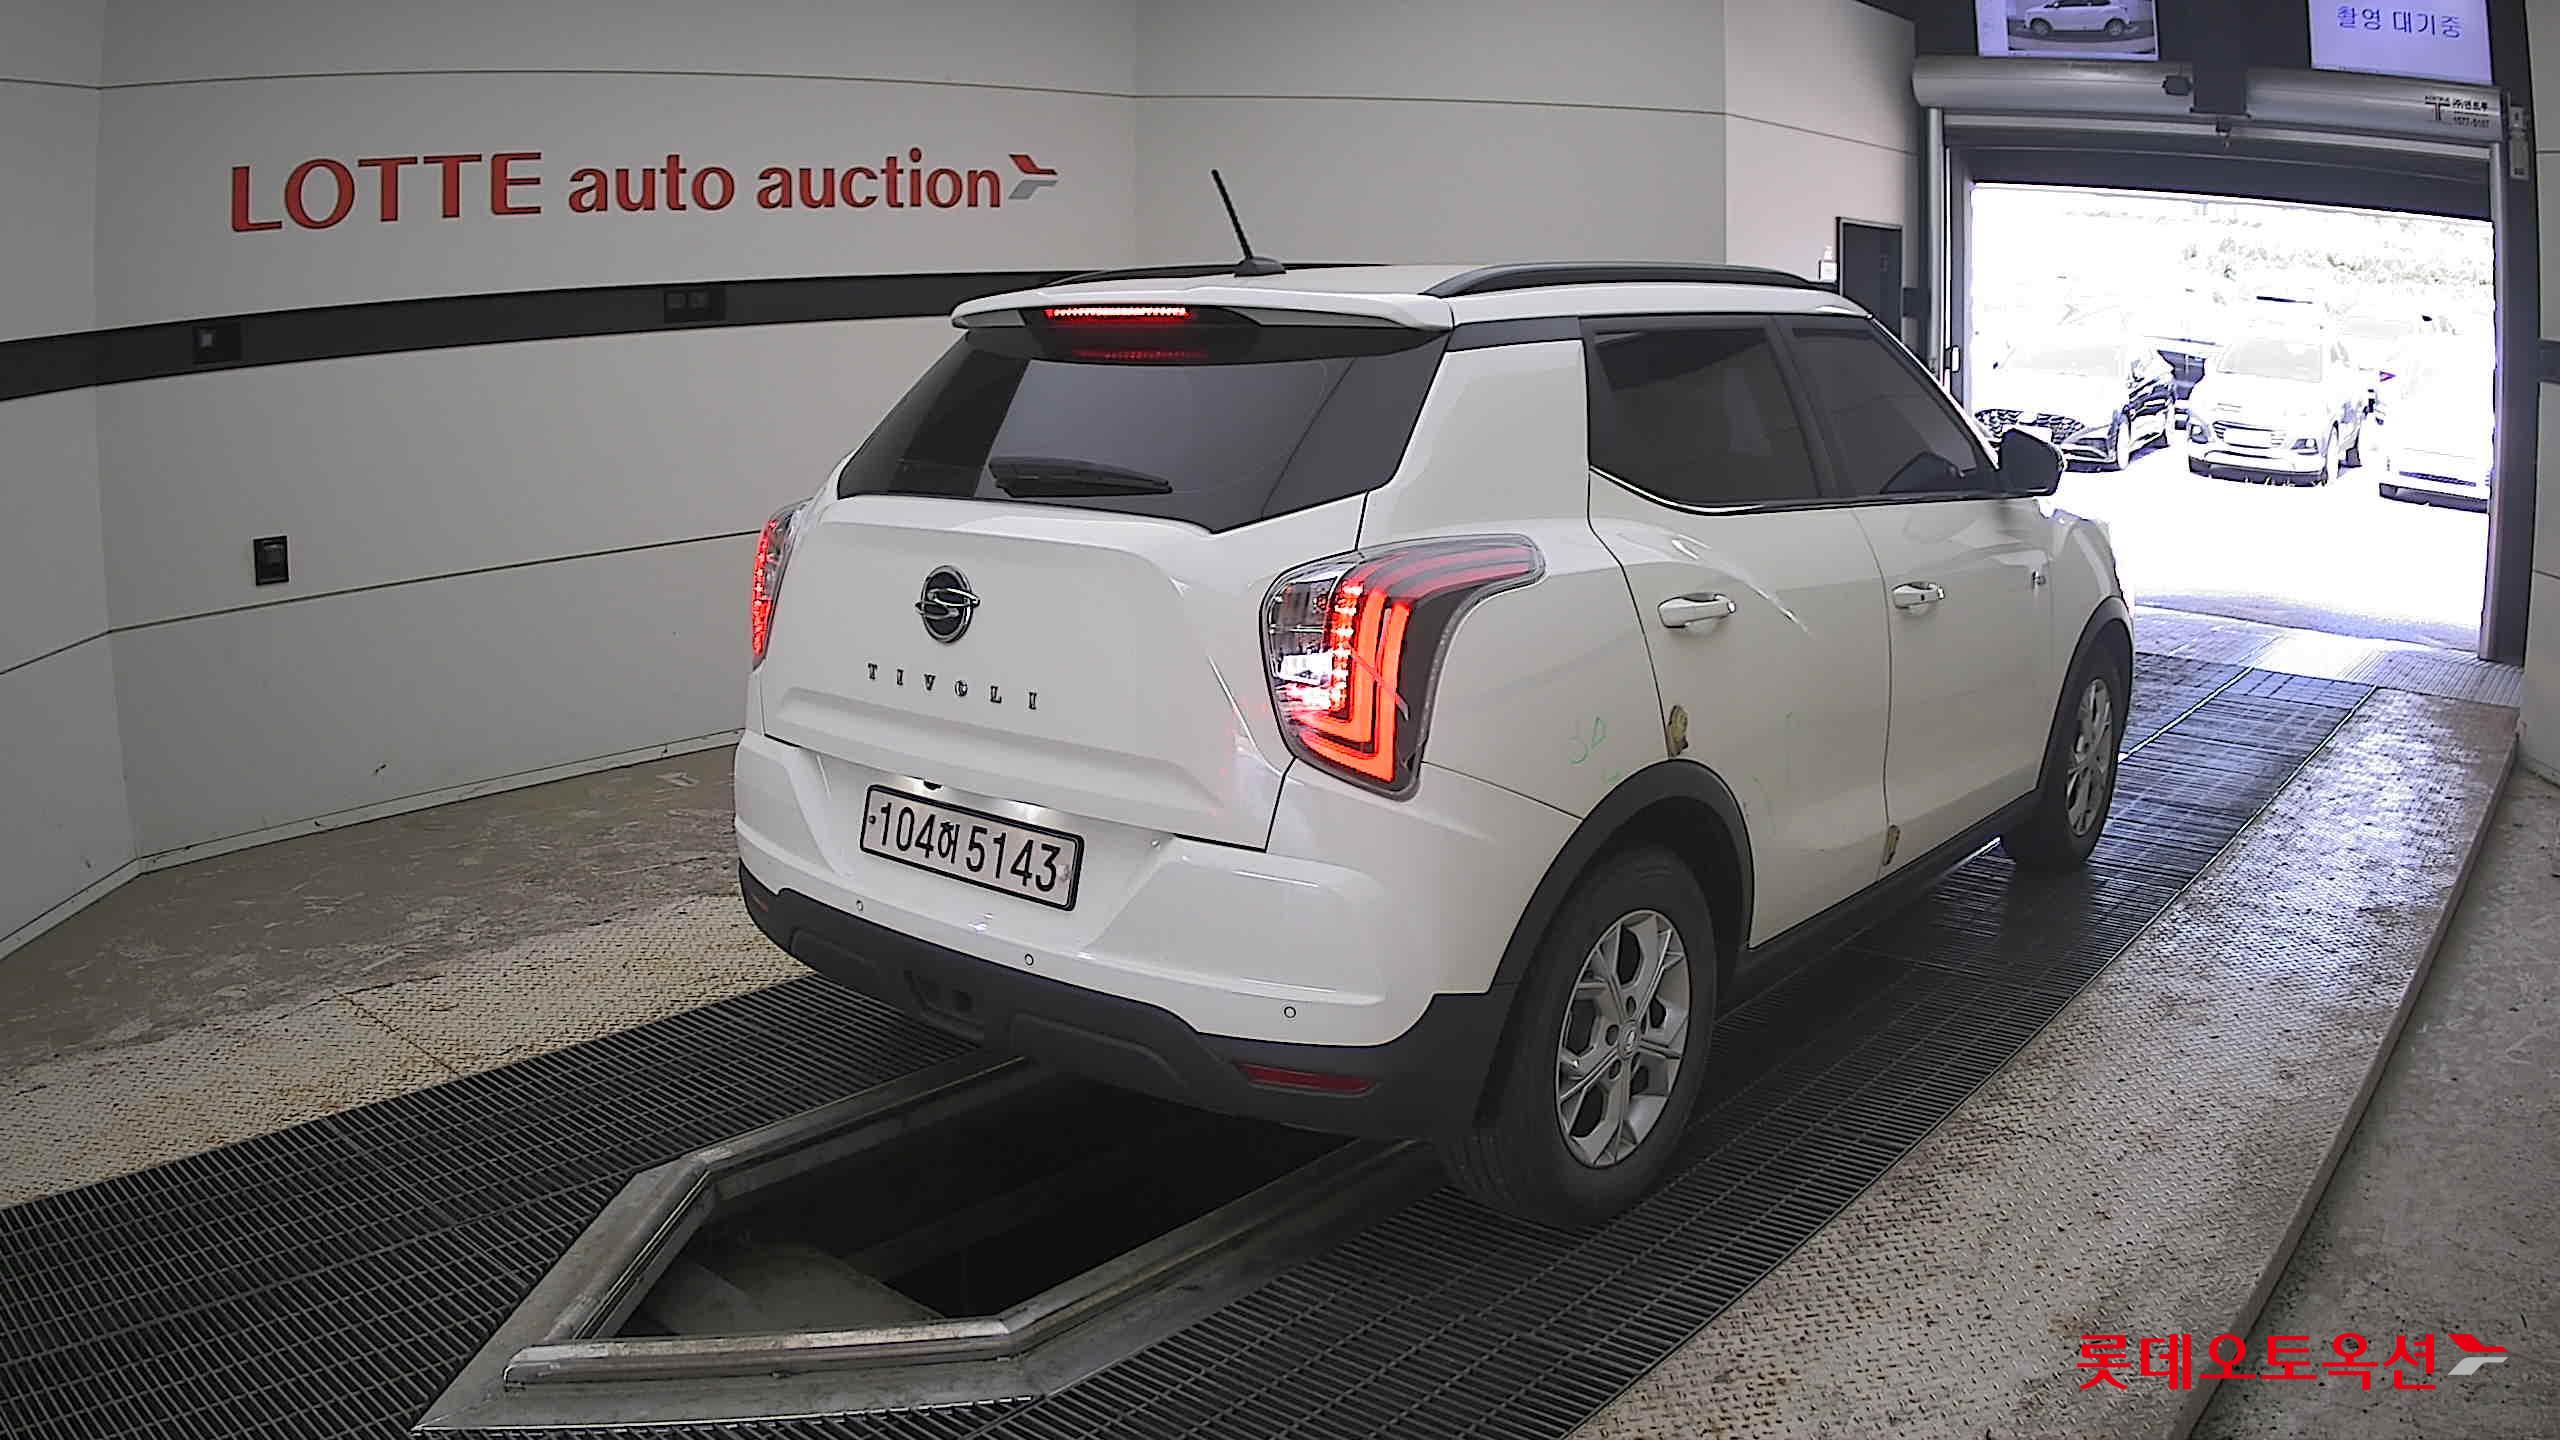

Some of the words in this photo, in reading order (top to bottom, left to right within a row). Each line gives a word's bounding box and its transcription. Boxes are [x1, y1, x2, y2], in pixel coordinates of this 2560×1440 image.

[2336, 5, 2382, 31] 촬영
[2392, 11, 2462, 39] 대기중
[230, 151, 542, 233] LOTTE
[568, 153, 736, 213] auto
[755, 147, 1004, 211] auction
[867, 662, 1038, 711] TIVOLI
